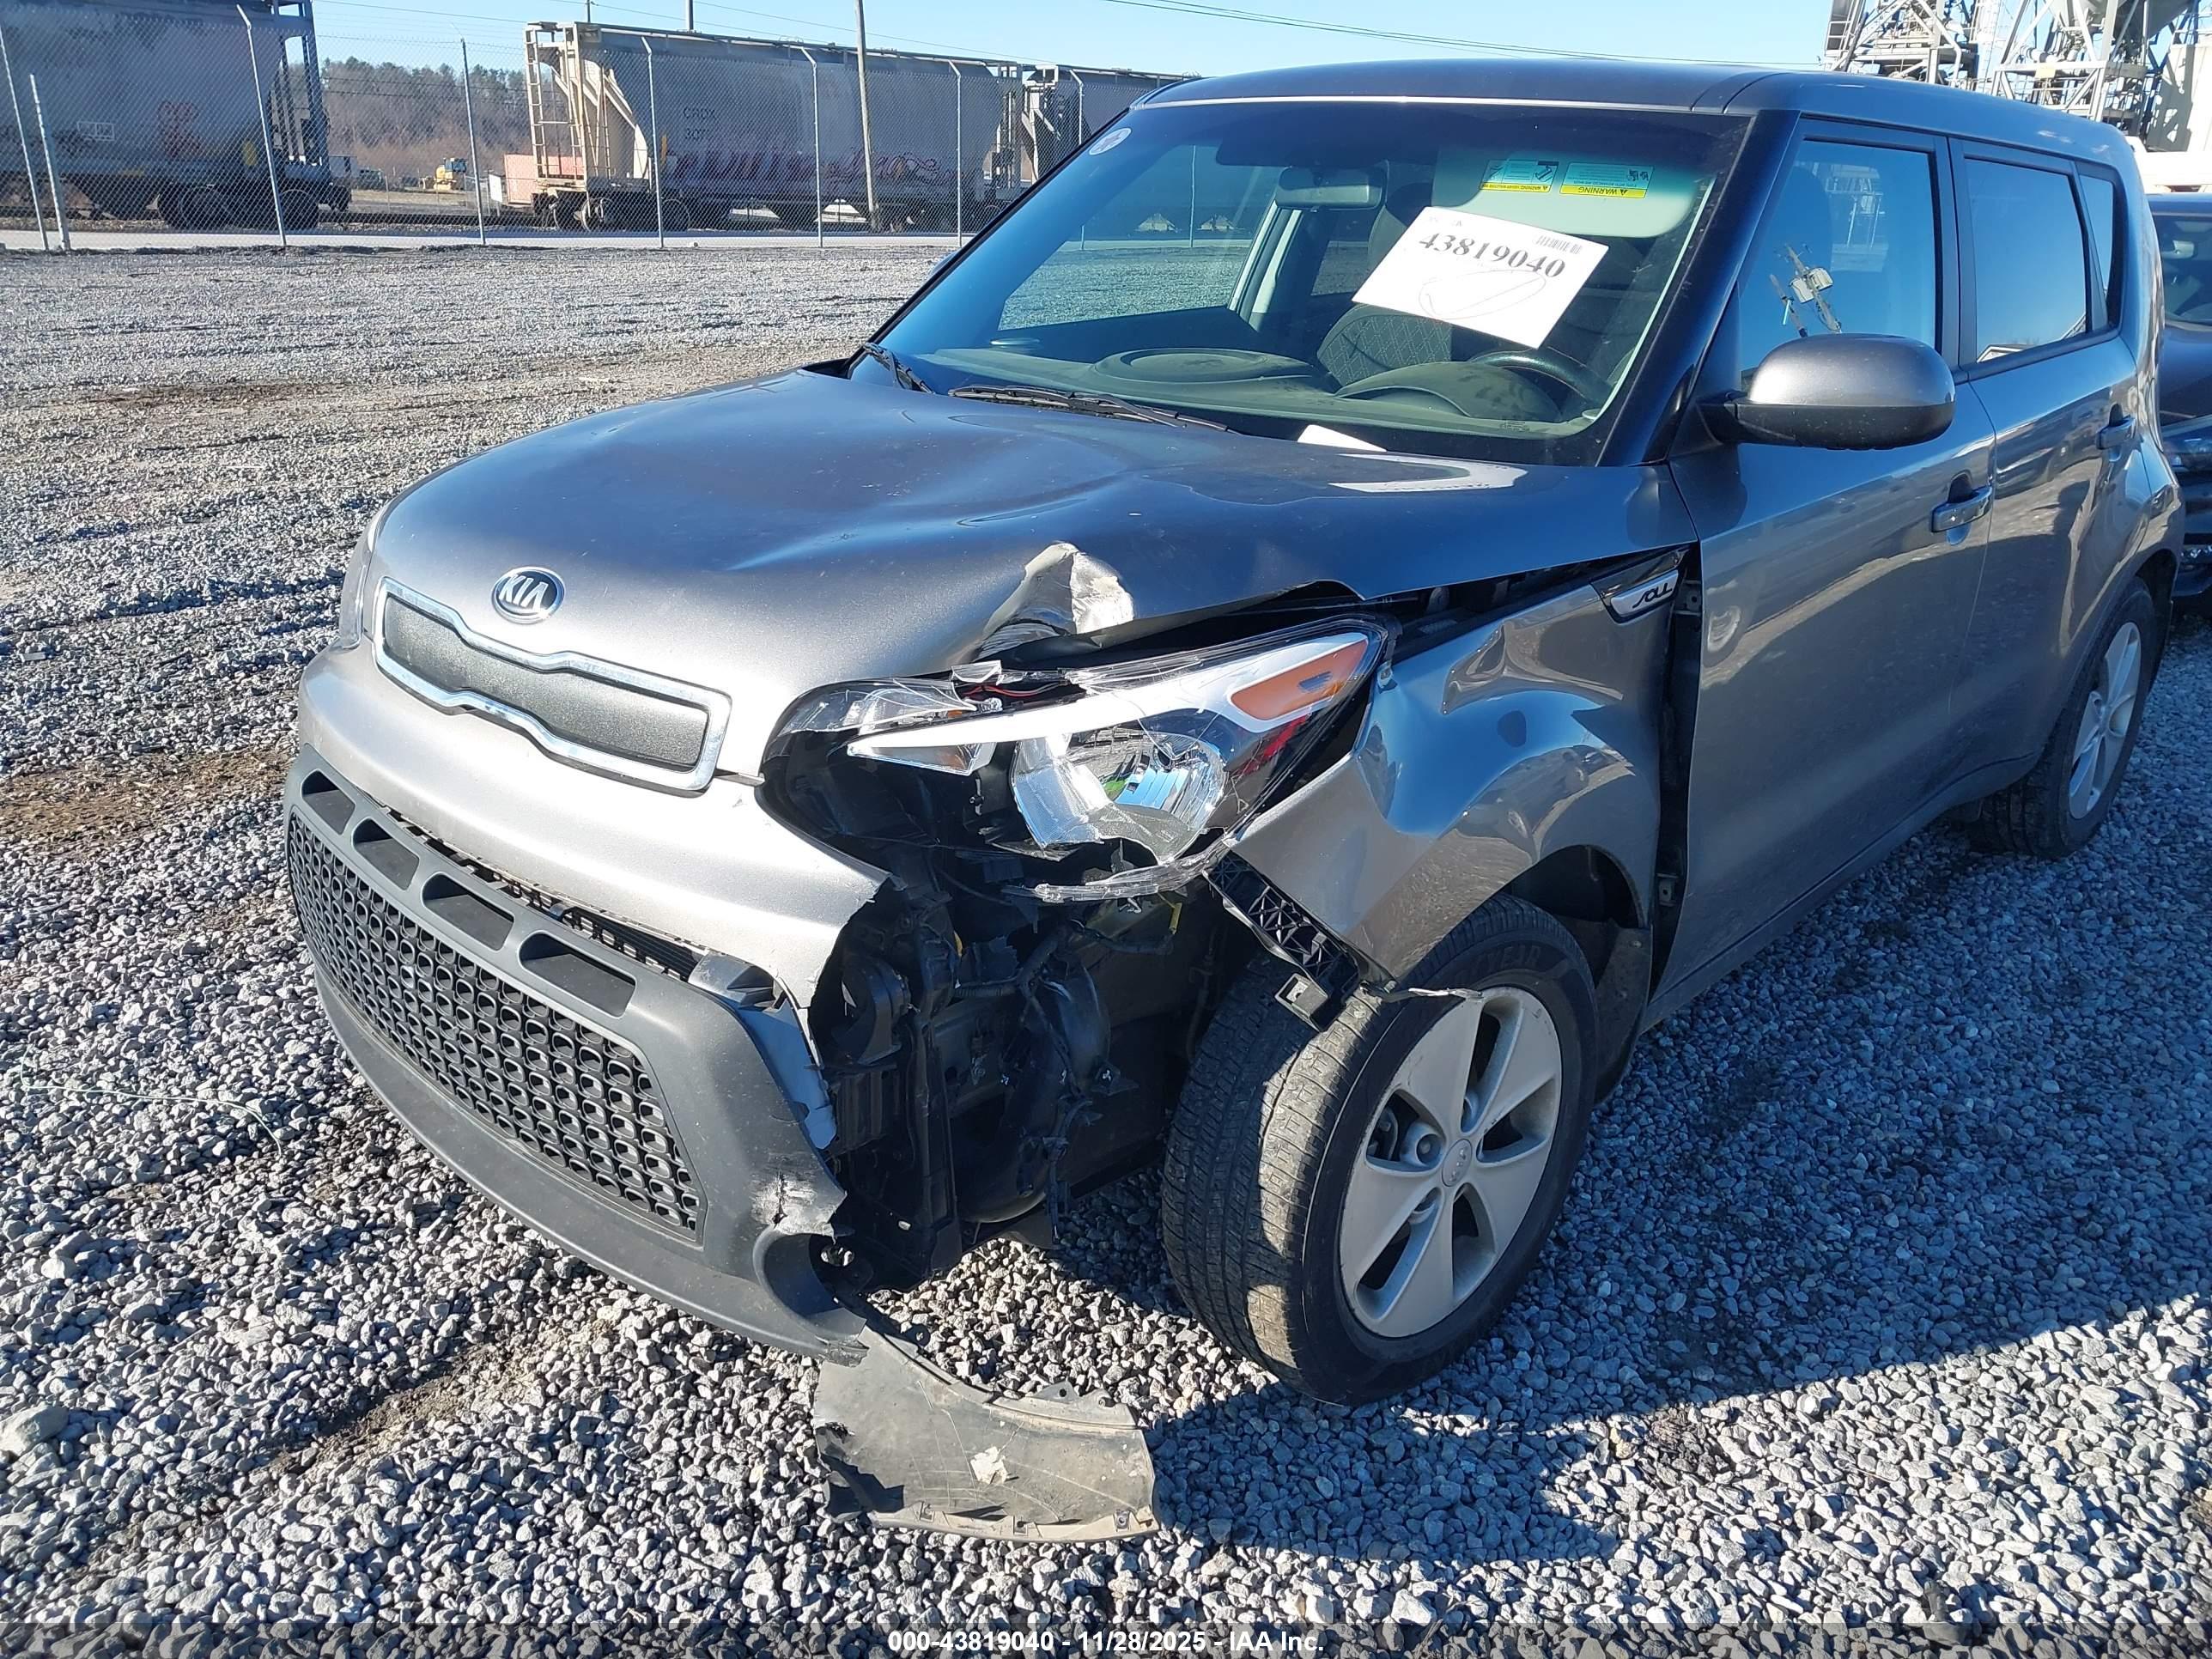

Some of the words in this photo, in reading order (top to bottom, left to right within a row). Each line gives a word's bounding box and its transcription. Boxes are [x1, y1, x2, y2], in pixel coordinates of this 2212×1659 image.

[1577, 185, 1619, 196] WARNING
[1419, 232, 1566, 278] 43819040
[498, 574, 550, 613] KIA
